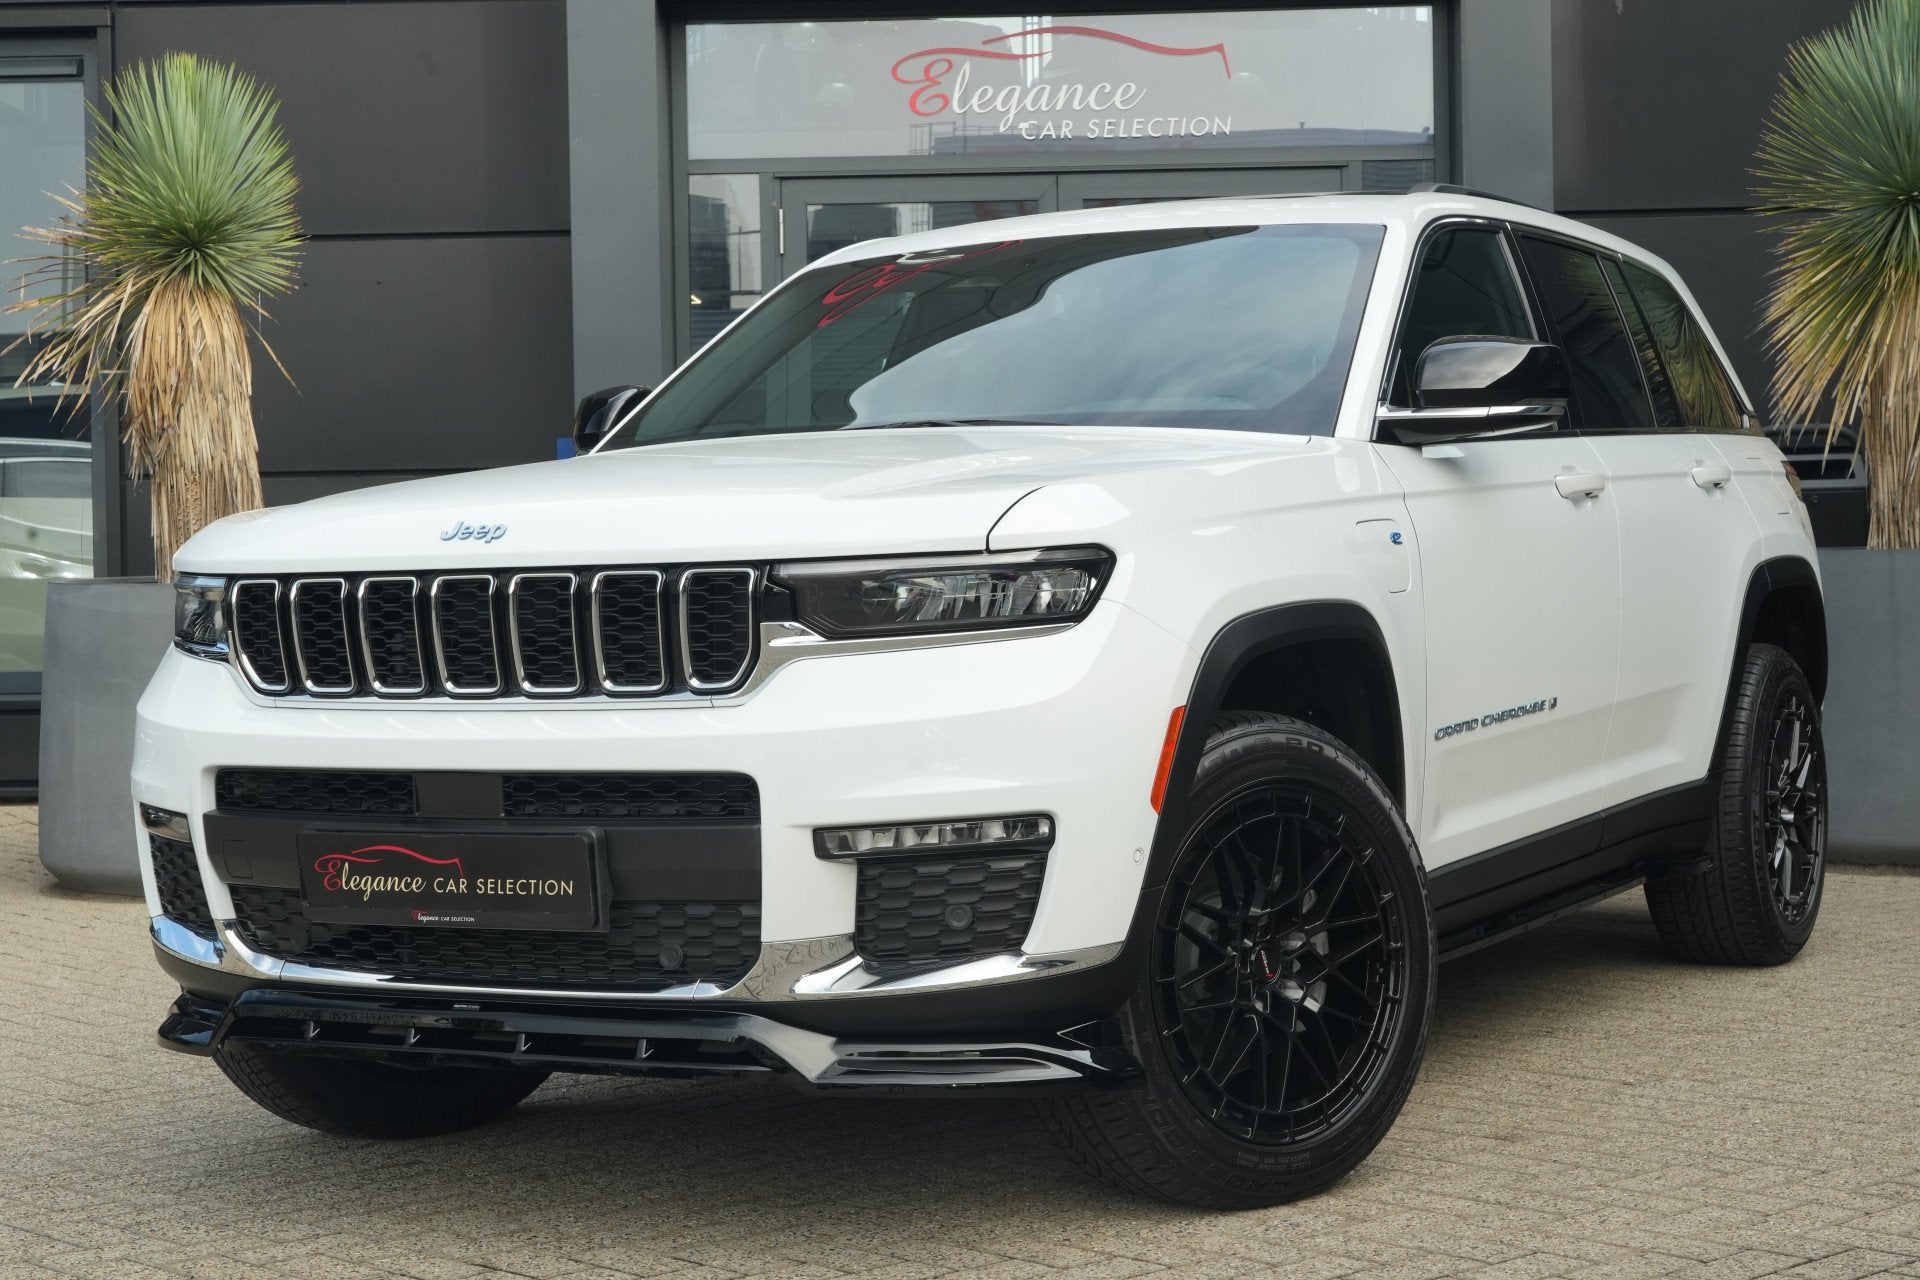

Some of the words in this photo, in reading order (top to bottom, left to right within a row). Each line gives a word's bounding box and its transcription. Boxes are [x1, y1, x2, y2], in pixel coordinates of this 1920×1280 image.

[892, 50, 1146, 133] Elegance
[1020, 119, 1073, 140] CAR
[1087, 116, 1232, 139] SELECTION
[440, 520, 508, 544] Jeep
[1434, 718, 1479, 741] GRAND
[1481, 699, 1547, 728] CHEROKEE
[315, 856, 426, 901] Elegance
[433, 877, 468, 893] CAR
[476, 878, 574, 896] SELECTION
